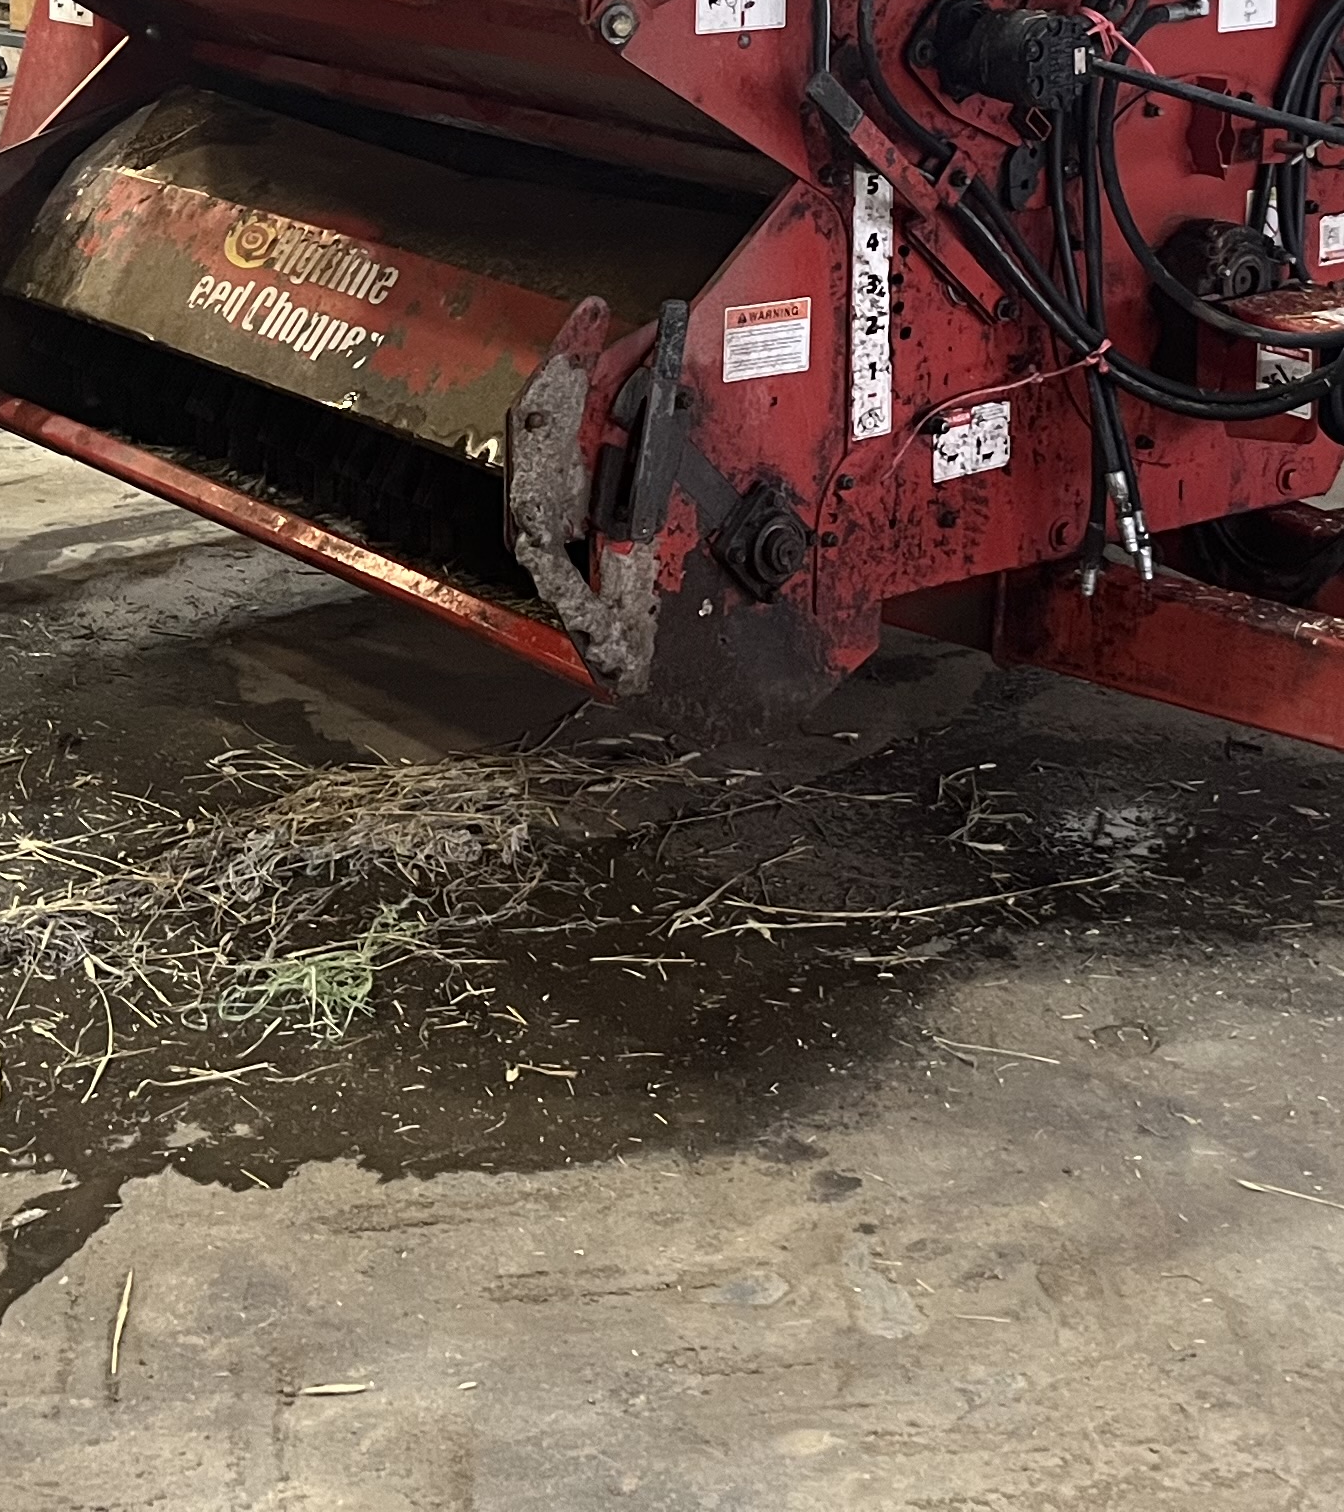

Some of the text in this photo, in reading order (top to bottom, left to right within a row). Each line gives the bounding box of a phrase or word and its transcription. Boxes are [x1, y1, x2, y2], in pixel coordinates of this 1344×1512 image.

[866, 174, 879, 195] 5
[866, 232, 879, 252] 4
[866, 273, 879, 295] 3
[748, 305, 799, 324] WARNING
[865, 315, 879, 336] 2
[868, 361, 877, 381] 1
